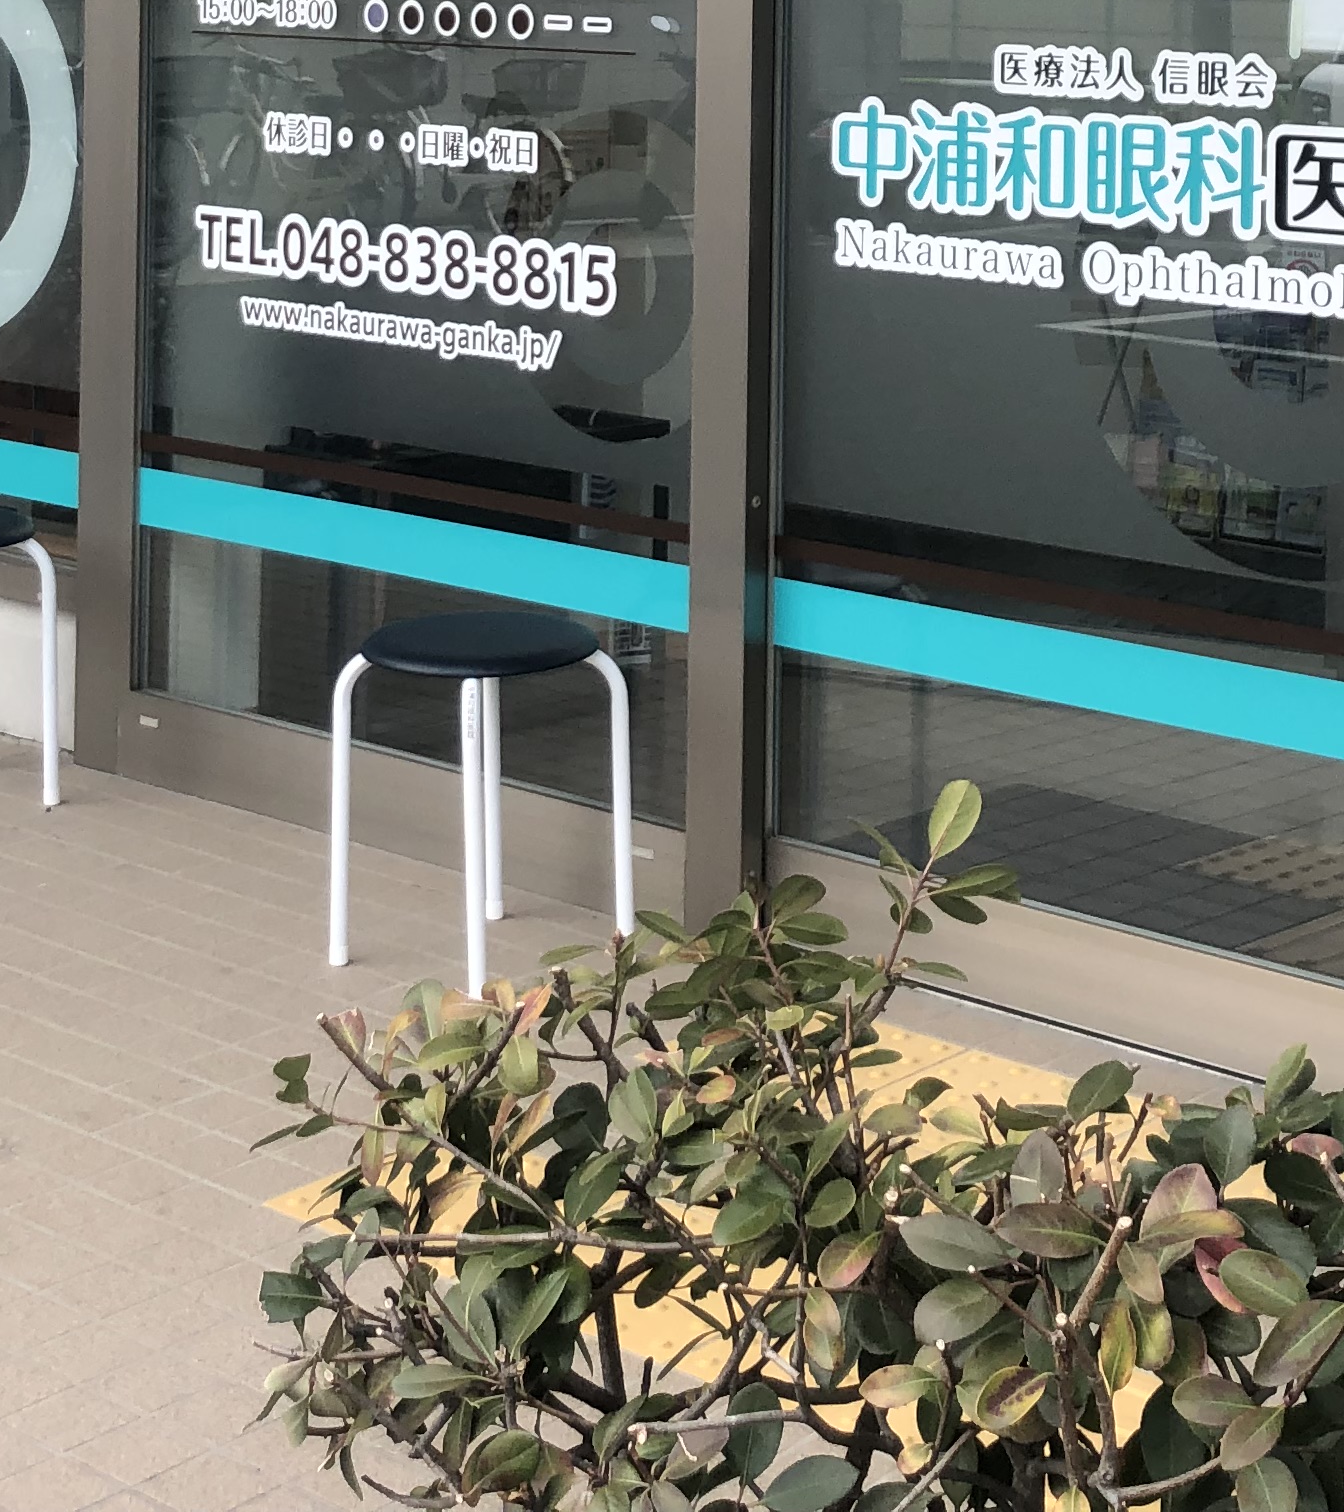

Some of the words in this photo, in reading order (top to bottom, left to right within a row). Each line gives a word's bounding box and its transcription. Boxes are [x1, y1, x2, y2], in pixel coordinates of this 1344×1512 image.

[1000, 52, 1141, 94] 医療法人
[1159, 56, 1272, 100] 信眼会
[199, 212, 612, 307] TEL.048-838-8815
[840, 225, 1058, 281] Nakaurawa
[243, 298, 559, 368] www.nakaurawa-ganka.jp/
